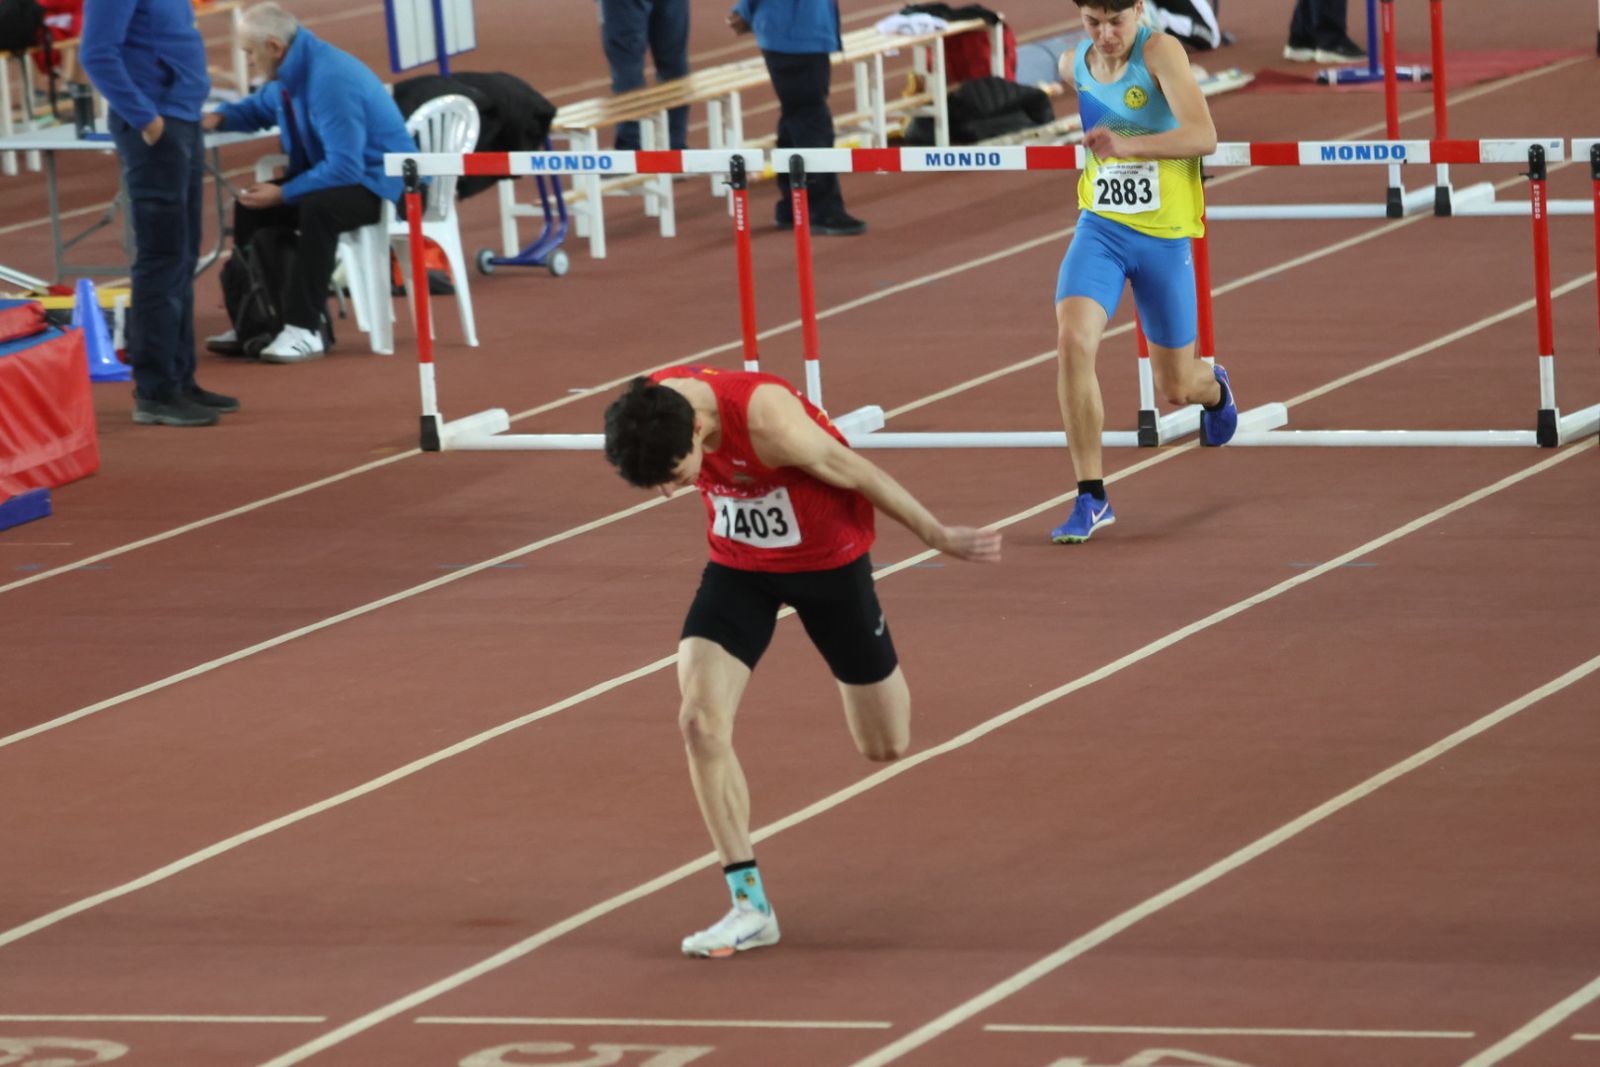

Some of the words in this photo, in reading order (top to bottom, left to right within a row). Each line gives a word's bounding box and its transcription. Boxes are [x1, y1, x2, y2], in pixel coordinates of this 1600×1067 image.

[925, 152, 1001, 167] MONDO
[1320, 144, 1407, 161] MONDO
[531, 155, 612, 171] MONDO
[1096, 177, 1153, 206] 2883
[721, 504, 789, 539] 1403
